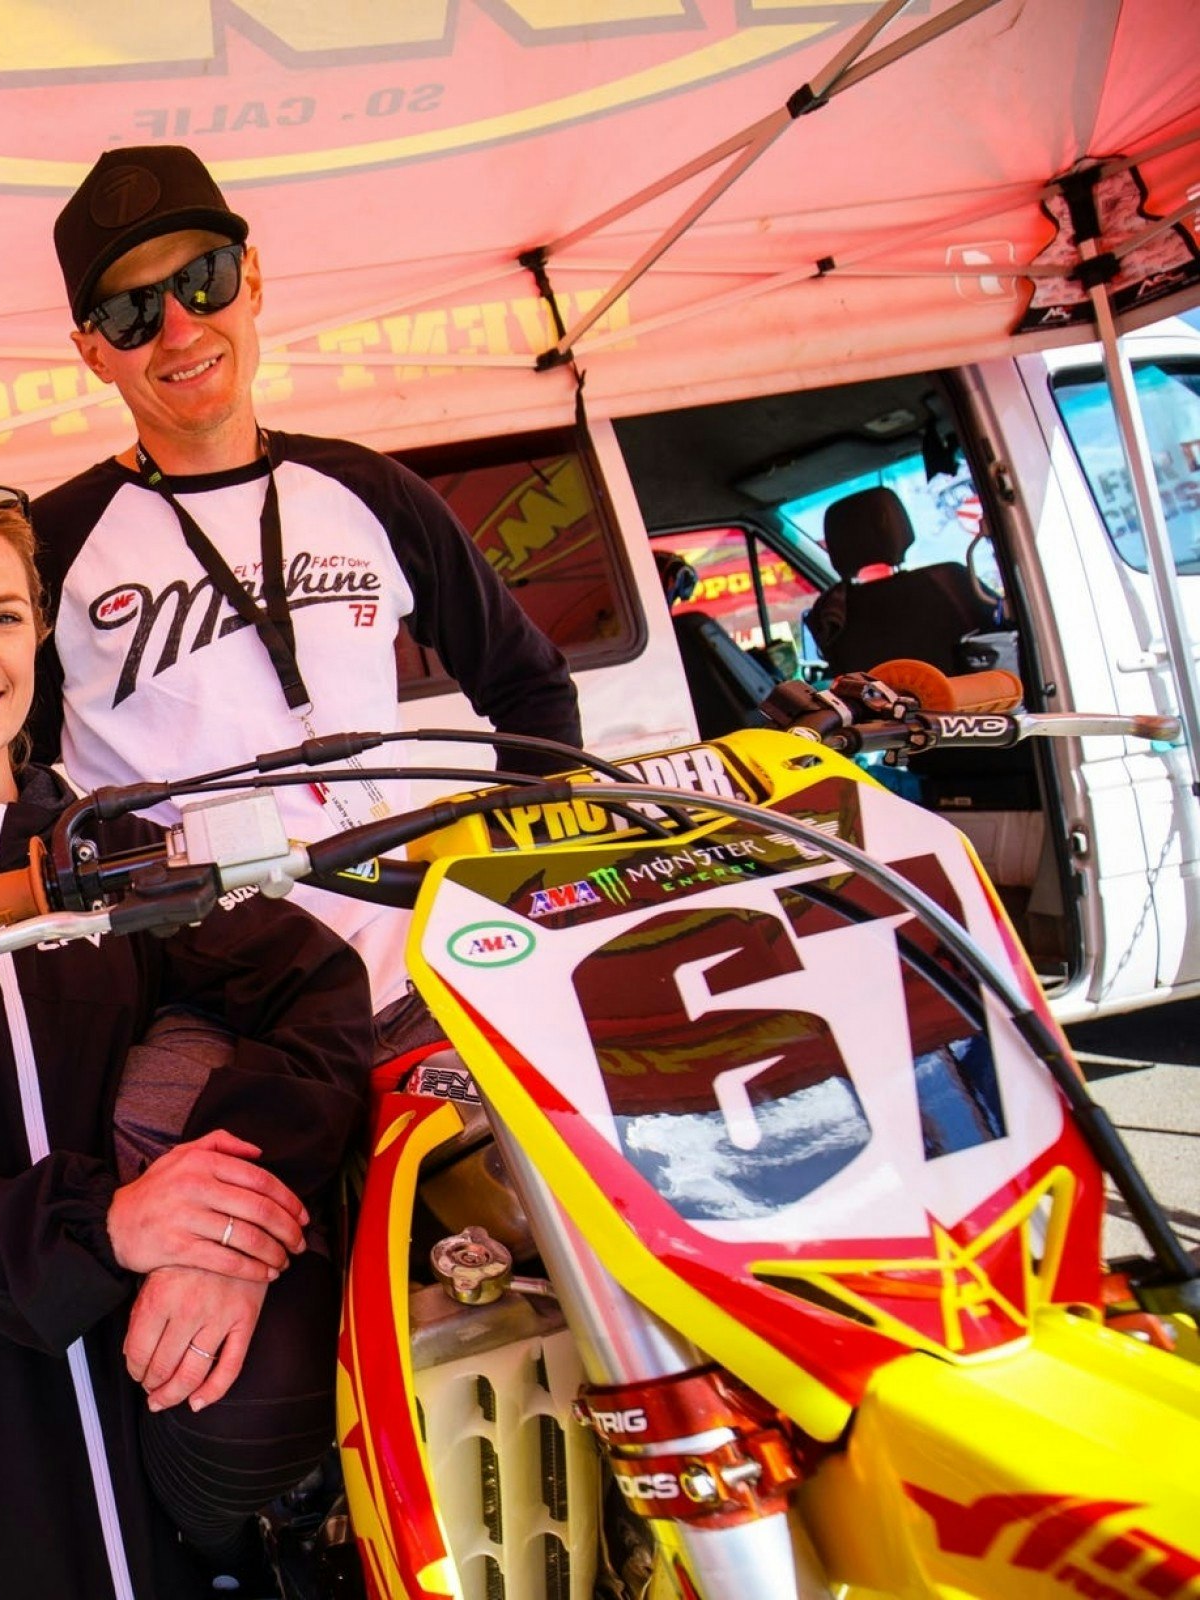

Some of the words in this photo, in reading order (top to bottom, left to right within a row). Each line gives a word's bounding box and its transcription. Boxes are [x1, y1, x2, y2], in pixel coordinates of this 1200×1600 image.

[311, 555, 371, 568] FACTORY
[99, 592, 136, 618] FMF
[349, 603, 378, 627] 73
[89, 552, 382, 710] Mahine
[662, 862, 757, 892] ENERGY
[529, 880, 601, 917] AMA
[469, 934, 517, 955] AMA
